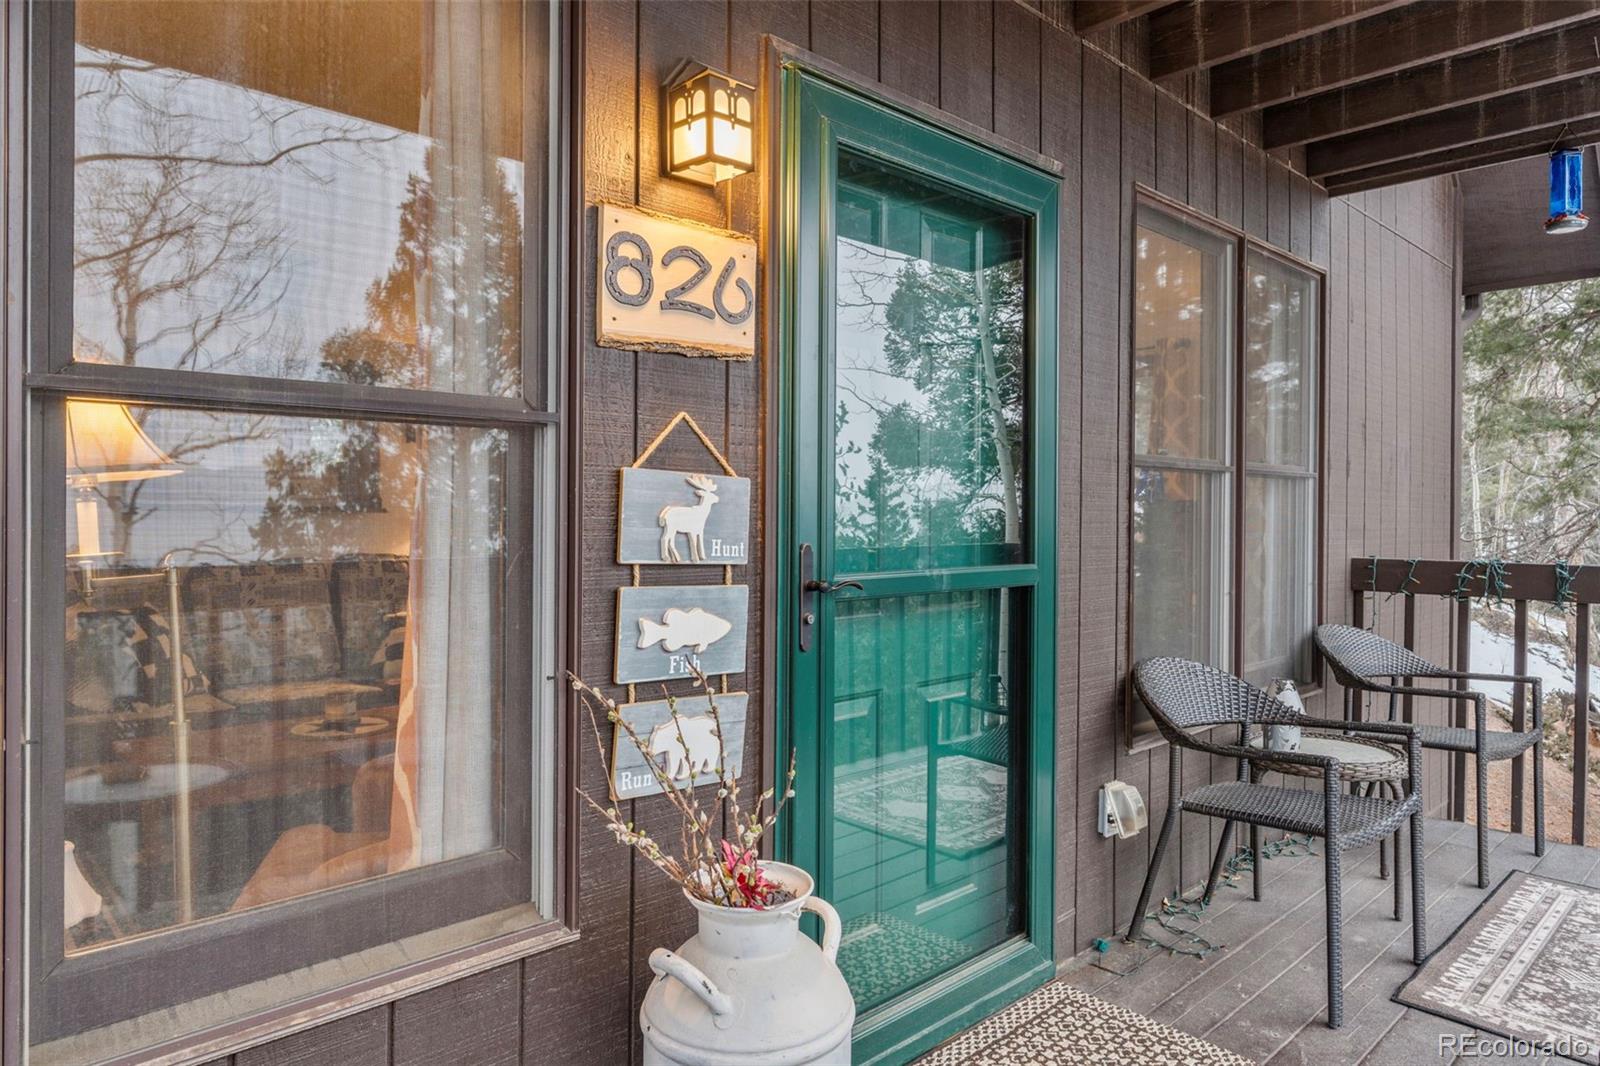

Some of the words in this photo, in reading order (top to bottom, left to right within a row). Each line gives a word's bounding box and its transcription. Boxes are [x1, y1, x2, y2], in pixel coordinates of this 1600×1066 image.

[605, 231, 753, 324] 826
[711, 539, 744, 557] Hunt
[621, 771, 652, 791] Run
